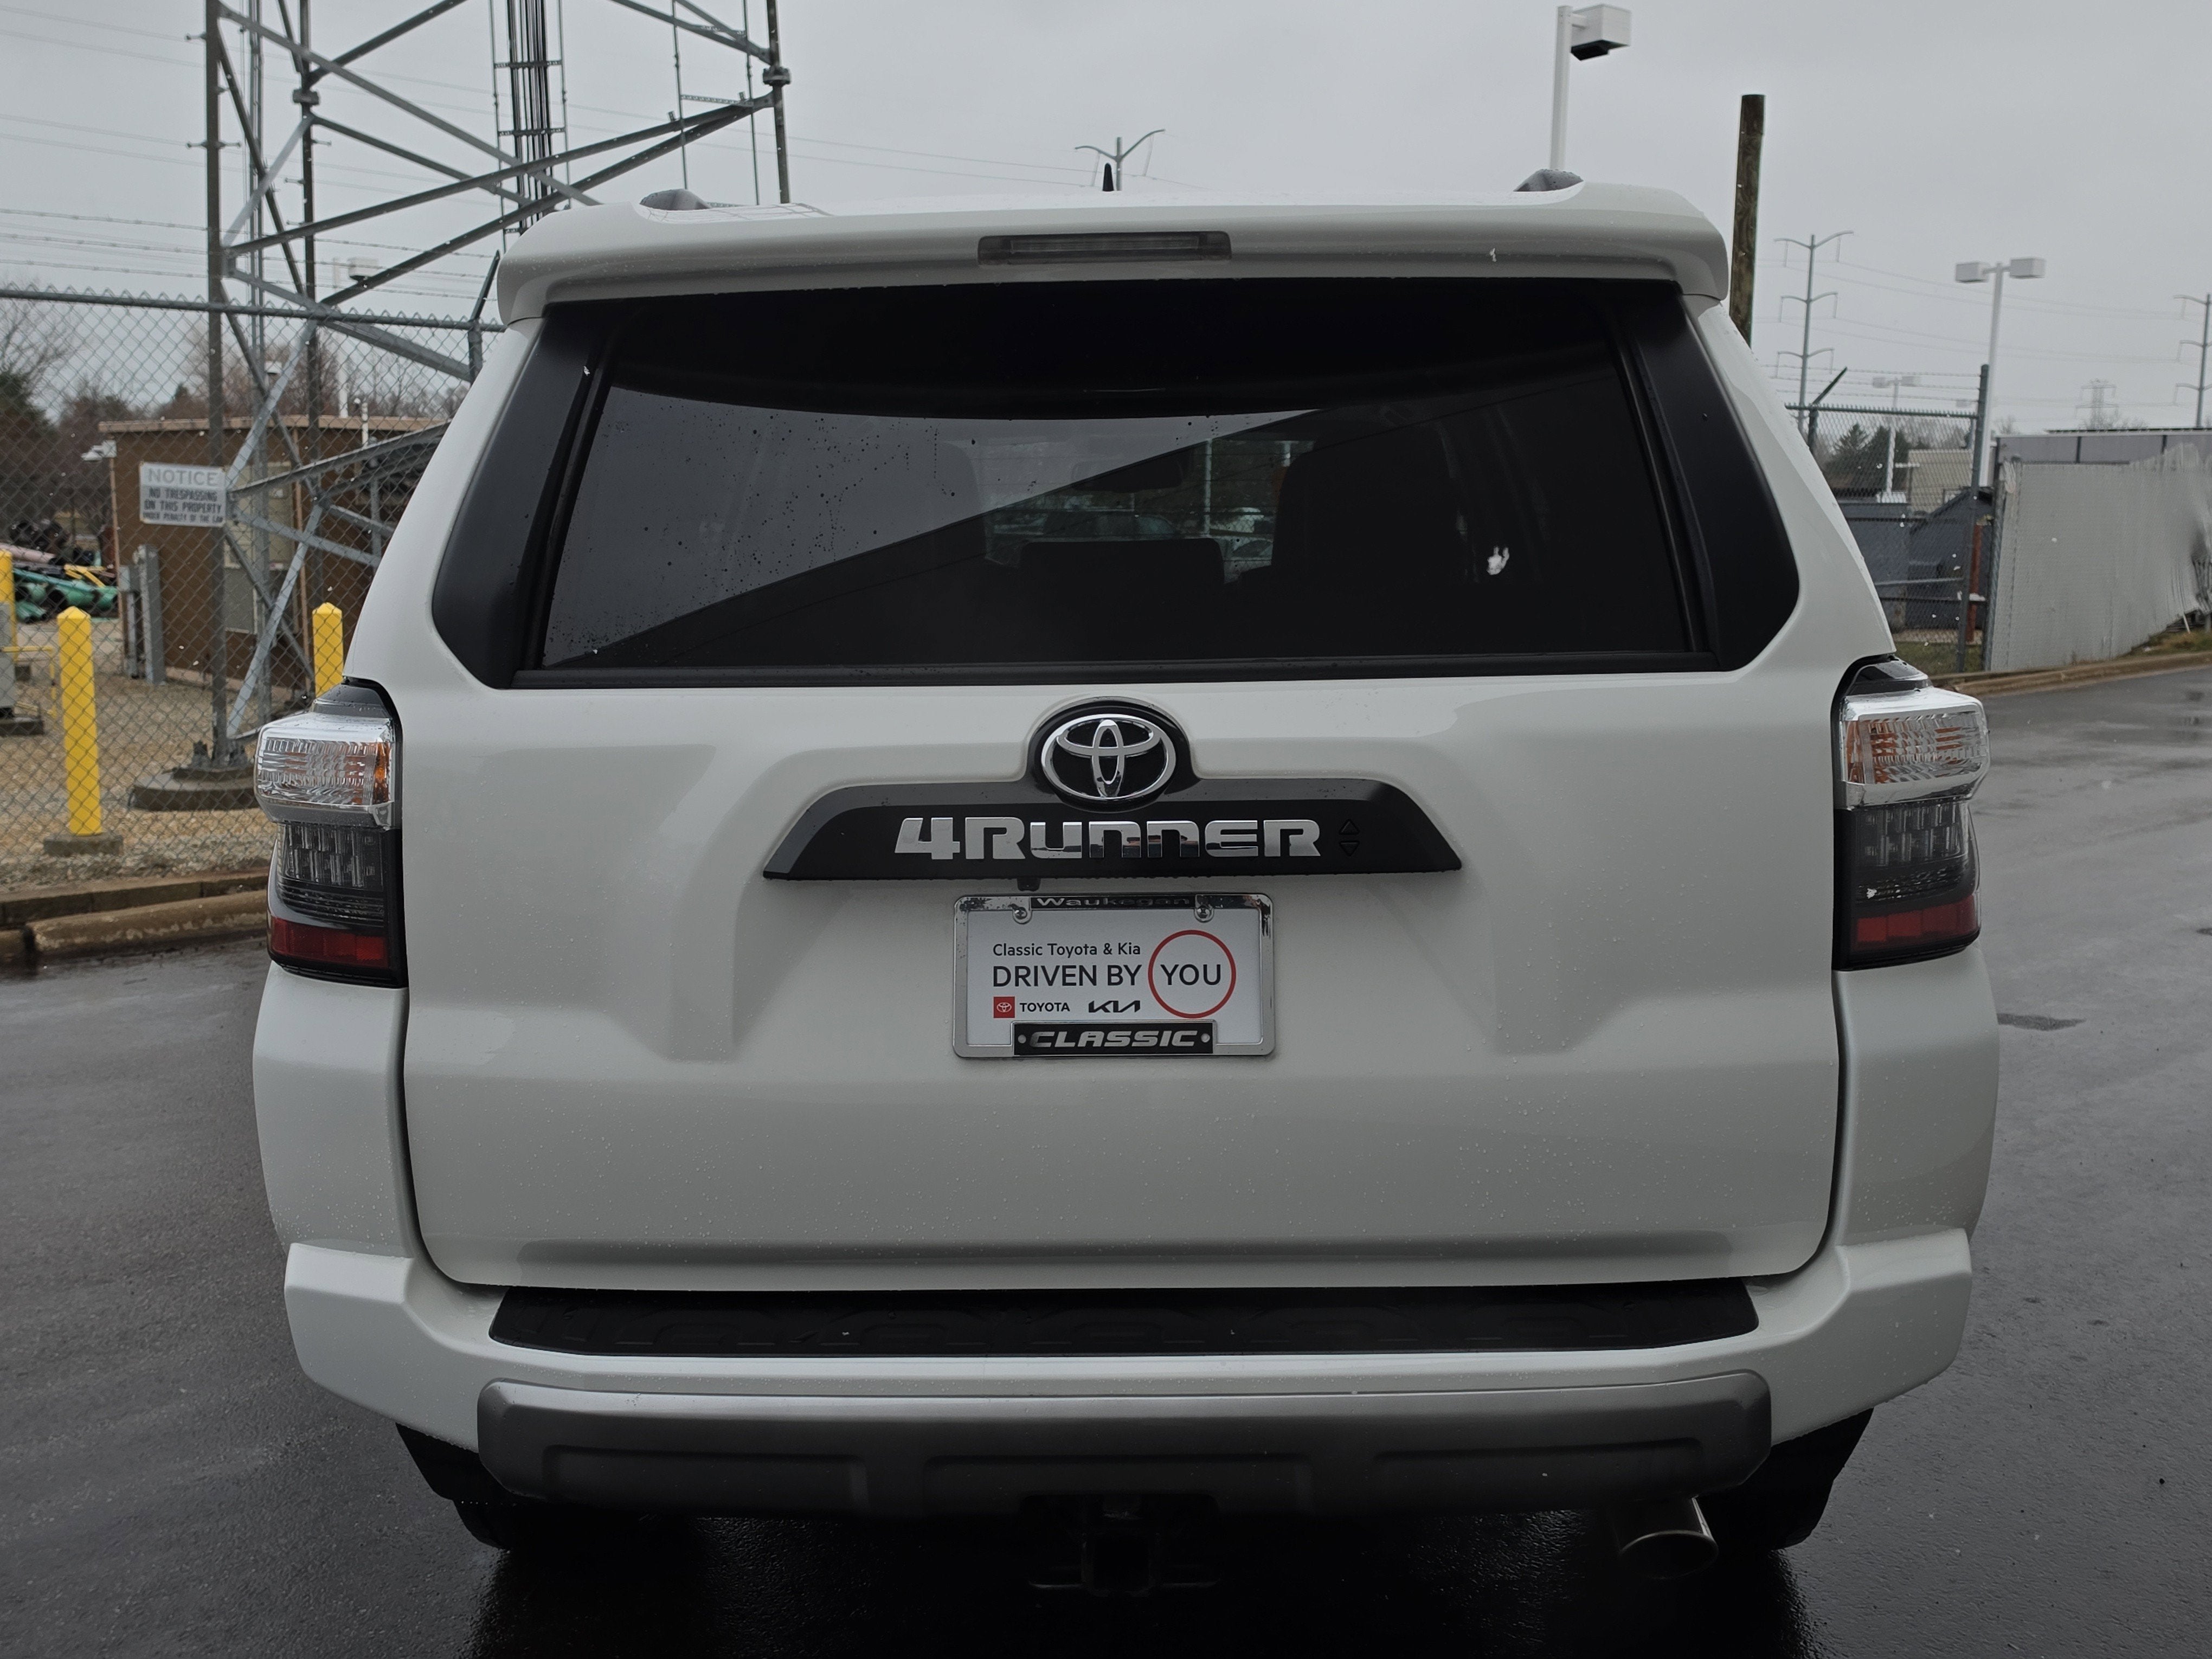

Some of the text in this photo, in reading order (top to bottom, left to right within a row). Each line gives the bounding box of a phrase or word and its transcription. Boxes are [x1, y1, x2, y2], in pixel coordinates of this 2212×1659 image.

[148, 468, 218, 486] NOTICE
[149, 487, 217, 502] NO TRESPASSING
[144, 499, 222, 513] ON THIS PROPERTY
[894, 816, 1321, 860] 4RUNNER
[1036, 896, 1190, 907] Waukegan
[993, 942, 1141, 958] Classic Toyota & Kia
[993, 964, 1221, 987] DRIVEN BY YOU
[1019, 1000, 1141, 1013] TOYOTA KIA
[1030, 1030, 1198, 1047] CLASSIC
